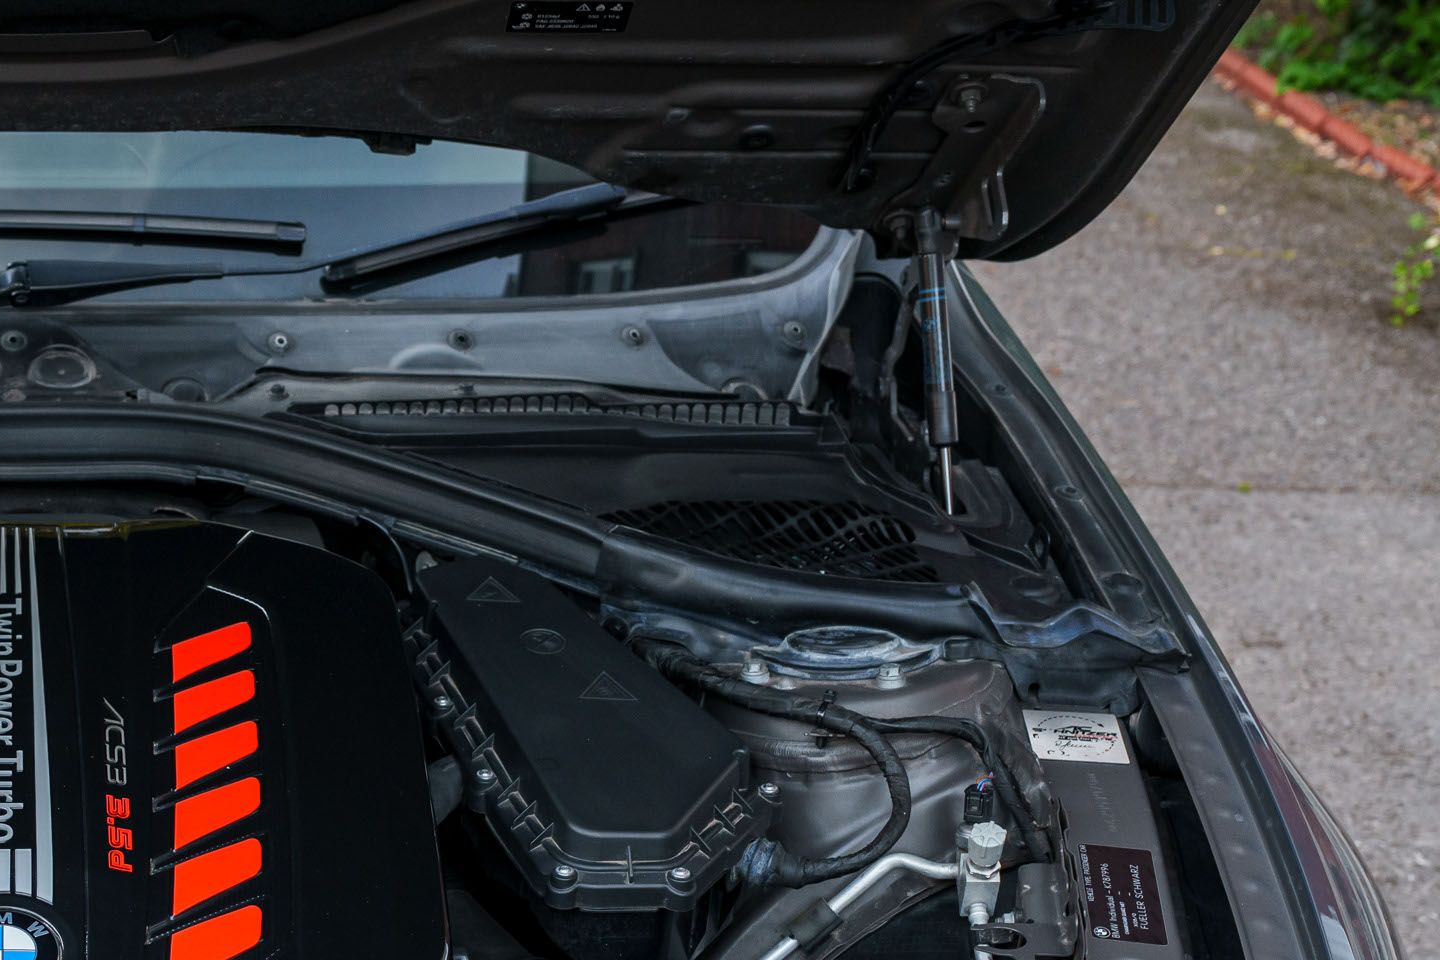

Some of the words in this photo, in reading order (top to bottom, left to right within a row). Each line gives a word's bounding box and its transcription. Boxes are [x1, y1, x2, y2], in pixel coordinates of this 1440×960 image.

[103, 696, 128, 787] ACS3
[106, 794, 134, 872] 3.5d
[1129, 864, 1144, 900] SCHWARZ
[1135, 900, 1149, 930] FUELLER
